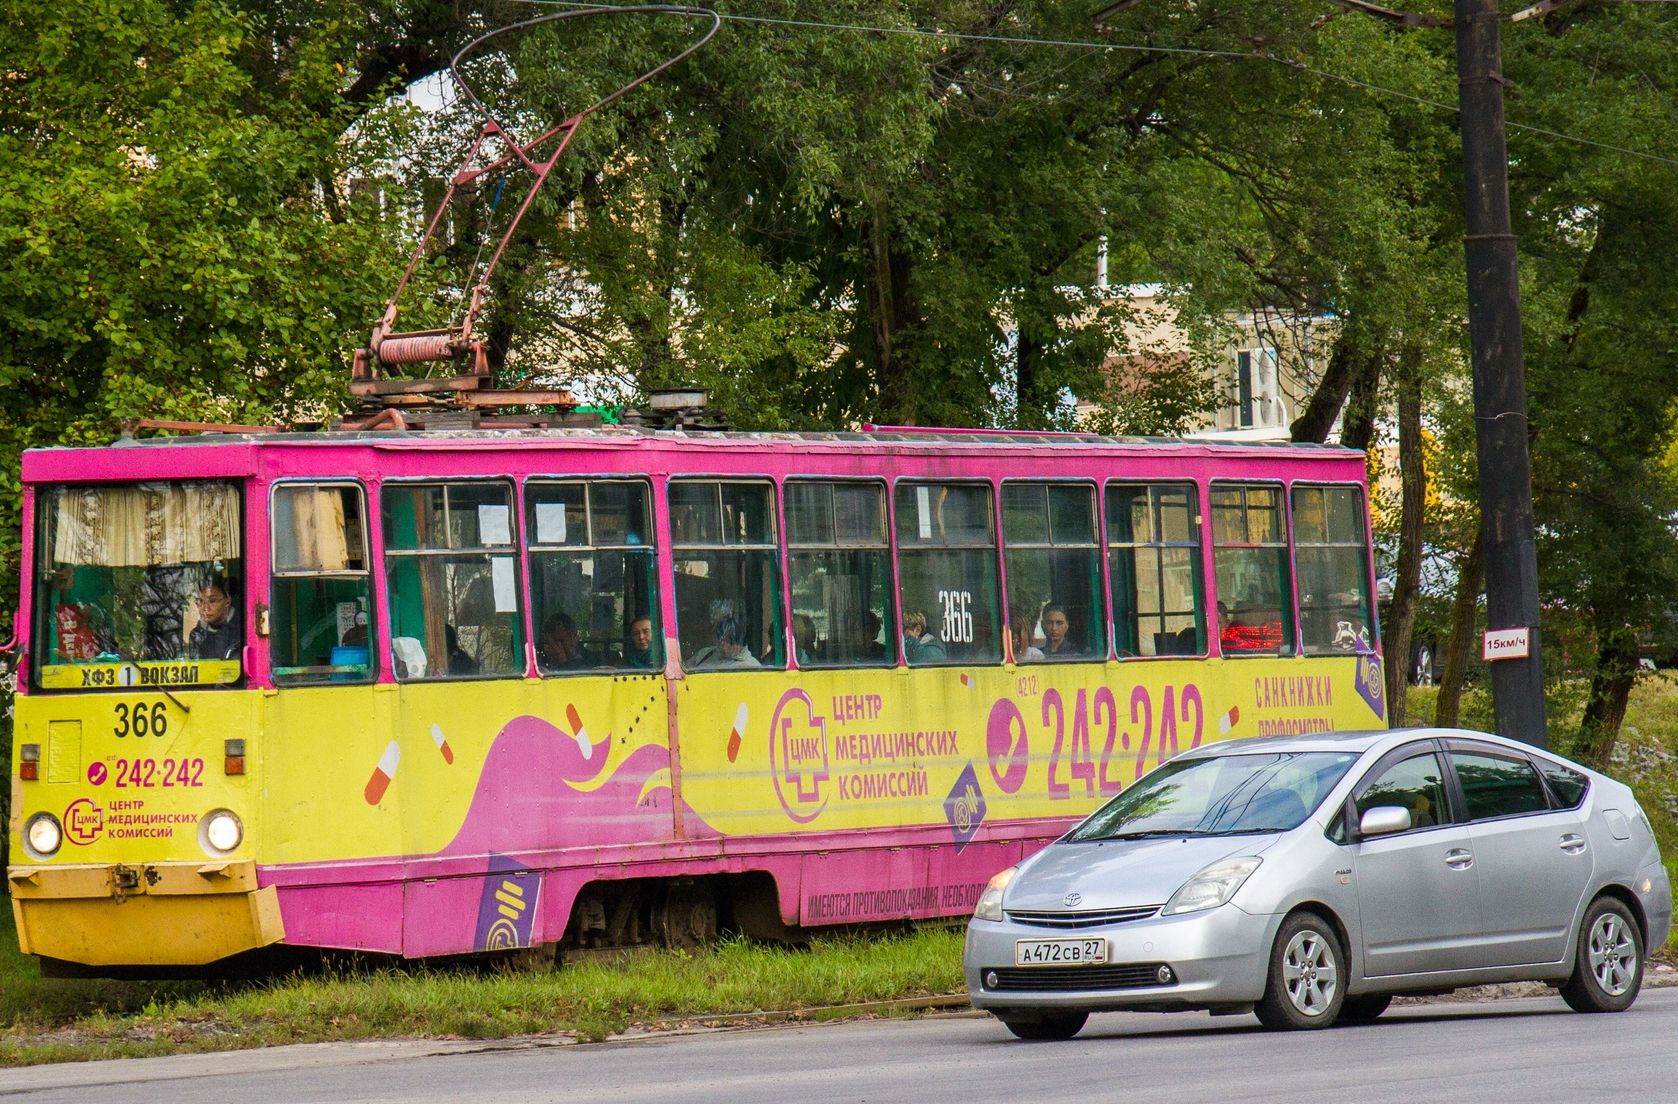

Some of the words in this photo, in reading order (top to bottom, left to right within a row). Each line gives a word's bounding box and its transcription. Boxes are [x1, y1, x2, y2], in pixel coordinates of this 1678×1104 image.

[938, 590, 973, 643] 366
[1487, 637, 1526, 650] 15км/ч
[124, 667, 131, 686] 1
[141, 666, 199, 684] ВОКЗАЛ
[1255, 675, 1333, 709] САНКНИЖКИ
[113, 701, 167, 738] 366
[832, 694, 882, 725] ЦЕНТР
[790, 737, 821, 765] ЦМК
[835, 731, 960, 765] МЕДИЦИНСКИХ
[838, 764, 930, 801] КОМИССИЙ
[109, 800, 145, 811] ЦЕНТР
[78, 815, 98, 825] ЦМК
[108, 813, 199, 826] МЕДИЦИНСКИХ
[108, 825, 173, 839] КОМИССИЙ
[807, 893, 851, 918] ИМЕЮТСЯ
[1085, 942, 1099, 955] 27
